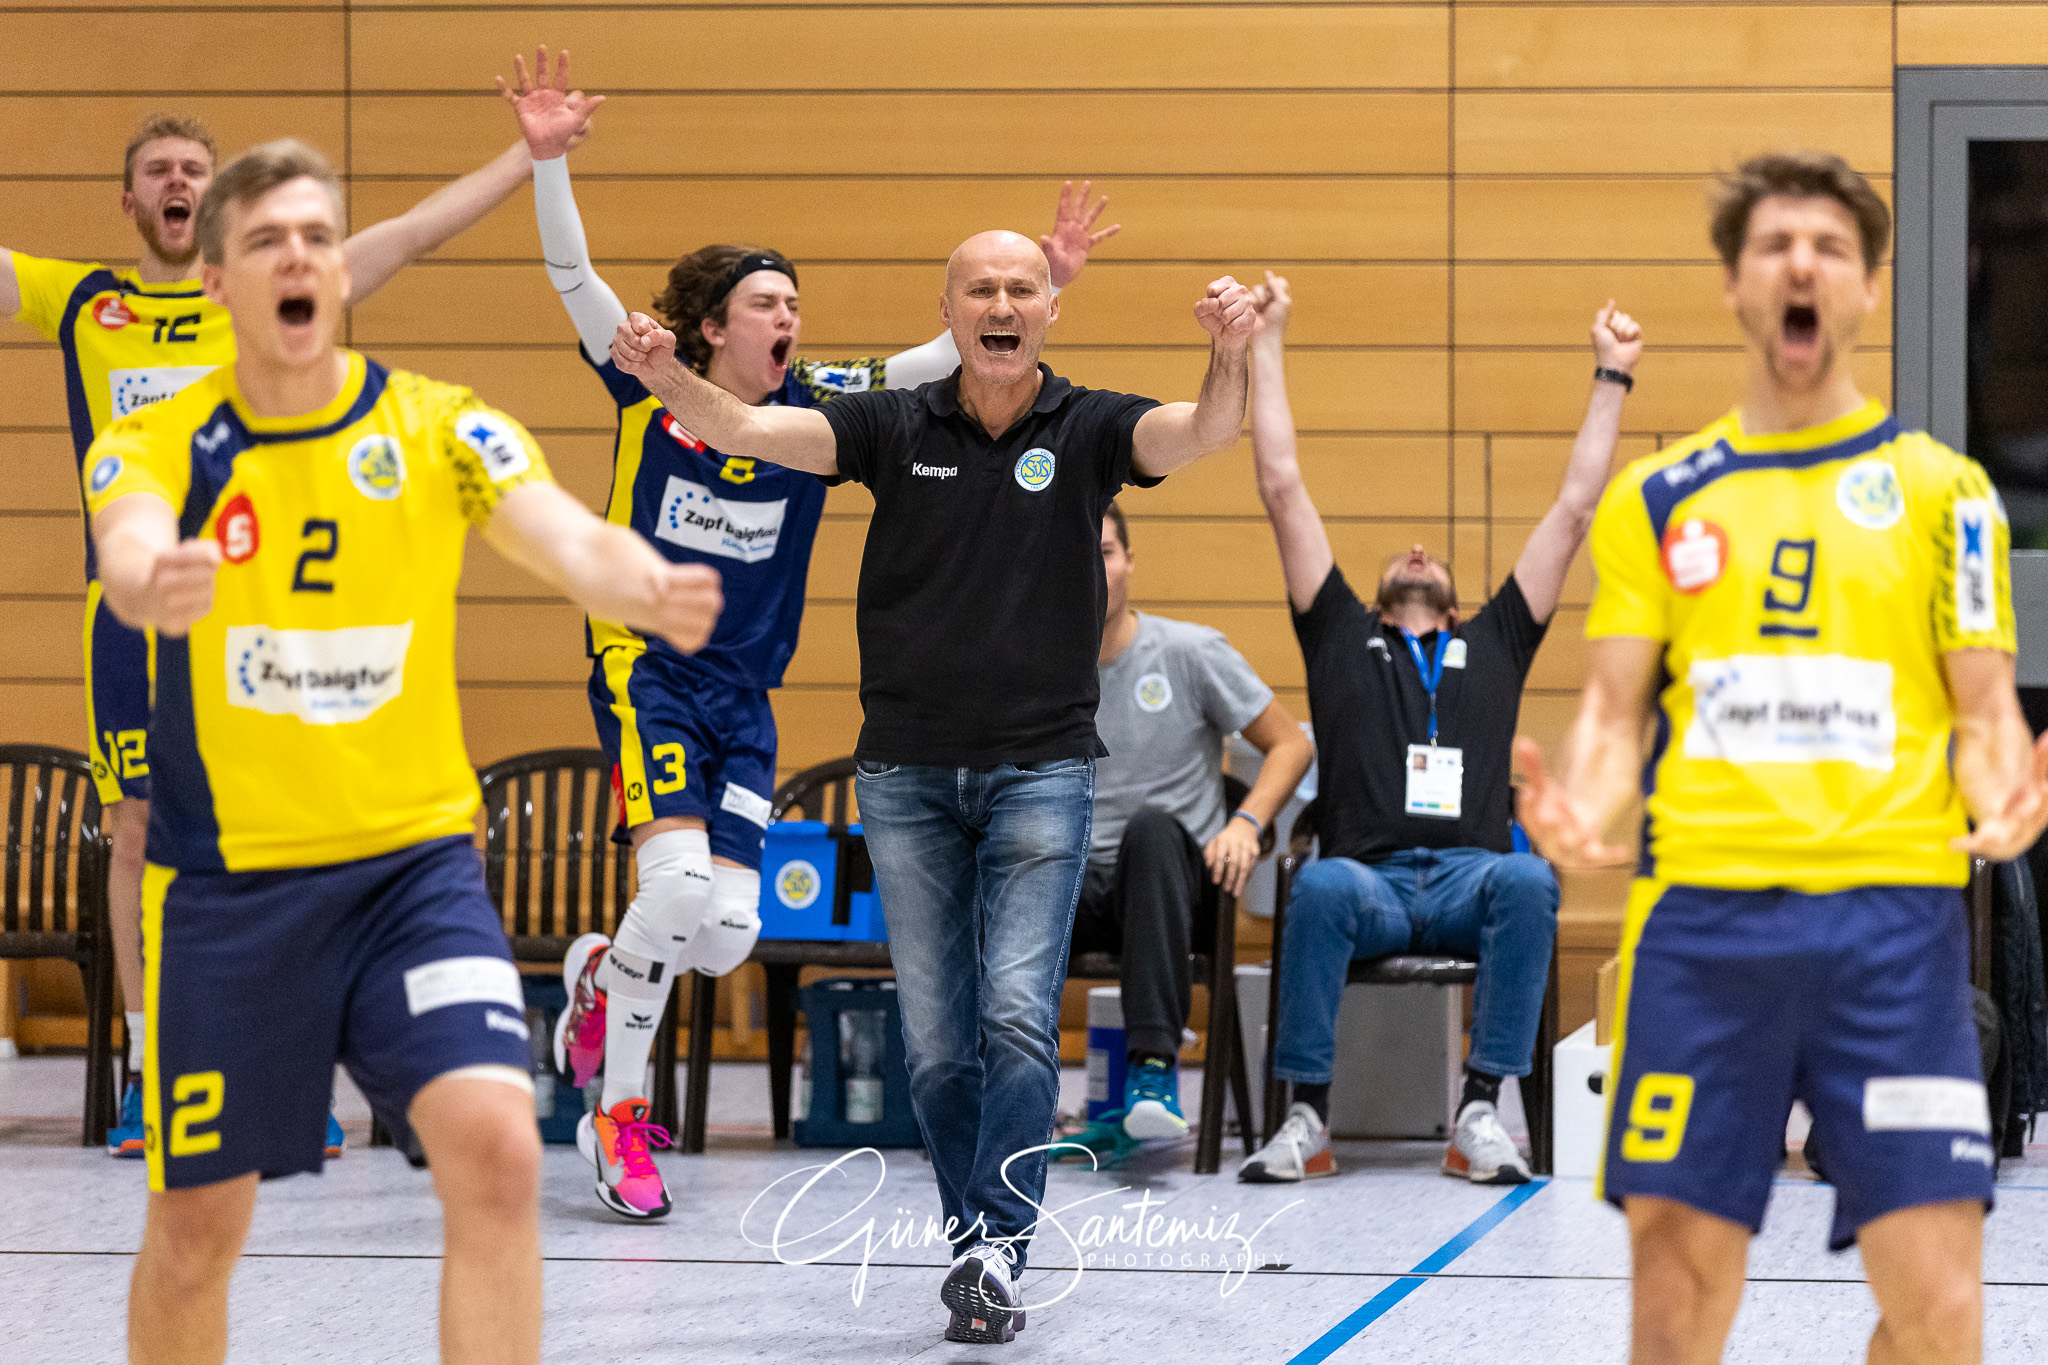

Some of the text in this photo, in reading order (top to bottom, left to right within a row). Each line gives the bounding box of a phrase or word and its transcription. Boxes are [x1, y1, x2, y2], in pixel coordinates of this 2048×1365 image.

[912, 462, 958, 480] Kempa
[684, 509, 724, 531] Zapf
[291, 519, 339, 592] 2
[1762, 538, 1816, 613] 9
[103, 728, 150, 780] 12
[652, 742, 687, 796] 3
[169, 1070, 225, 1158] 2
[1621, 1073, 1696, 1163] 9
